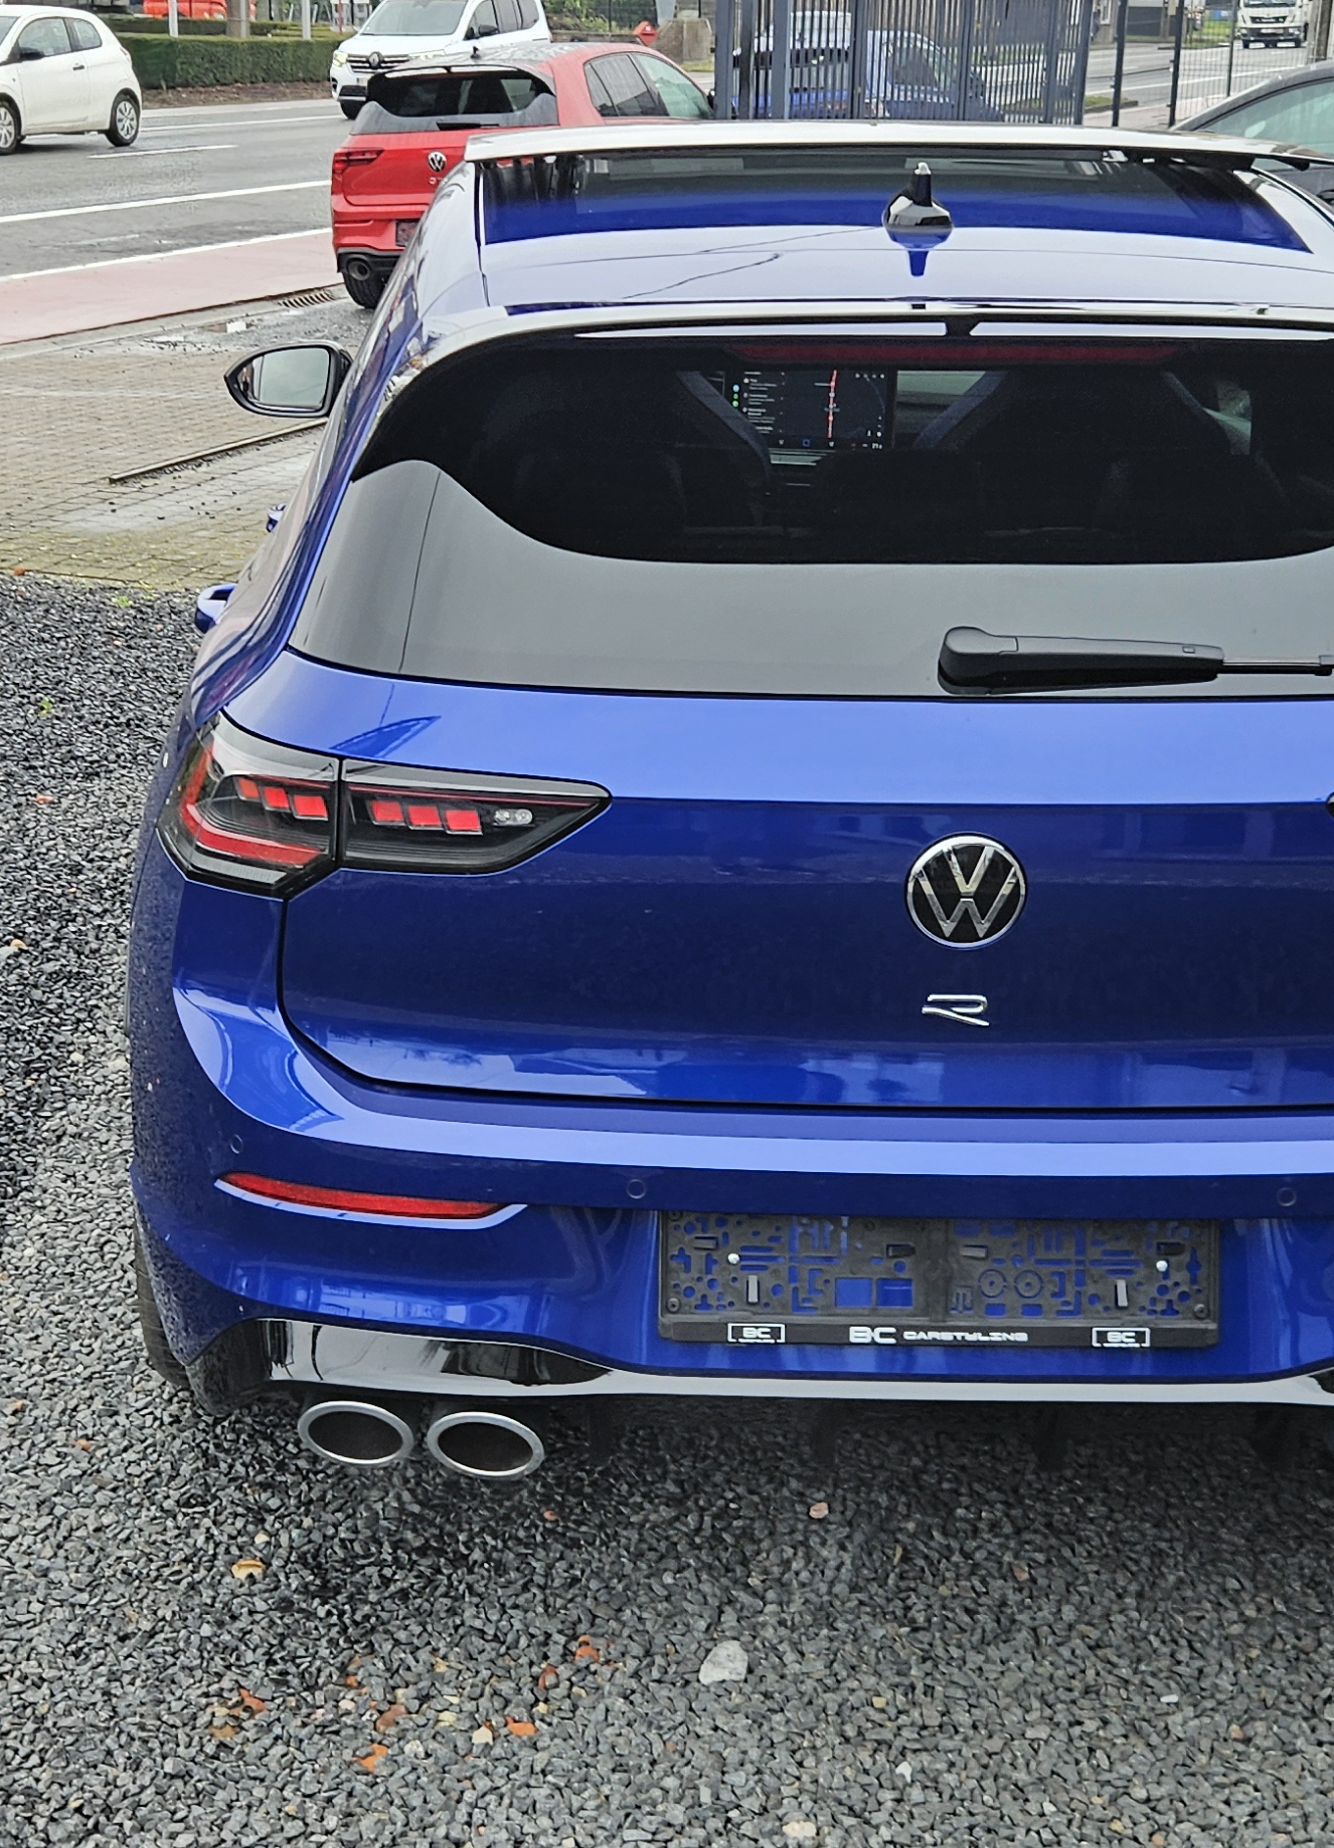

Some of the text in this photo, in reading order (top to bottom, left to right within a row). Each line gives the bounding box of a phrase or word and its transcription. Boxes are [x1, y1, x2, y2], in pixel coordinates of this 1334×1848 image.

[910, 837, 1022, 945] VW
[921, 994, 990, 1027] R
[742, 1327, 771, 1339] BC
[849, 1326, 1028, 1344] BC CARSTYLING
[1107, 1331, 1136, 1343] BC
